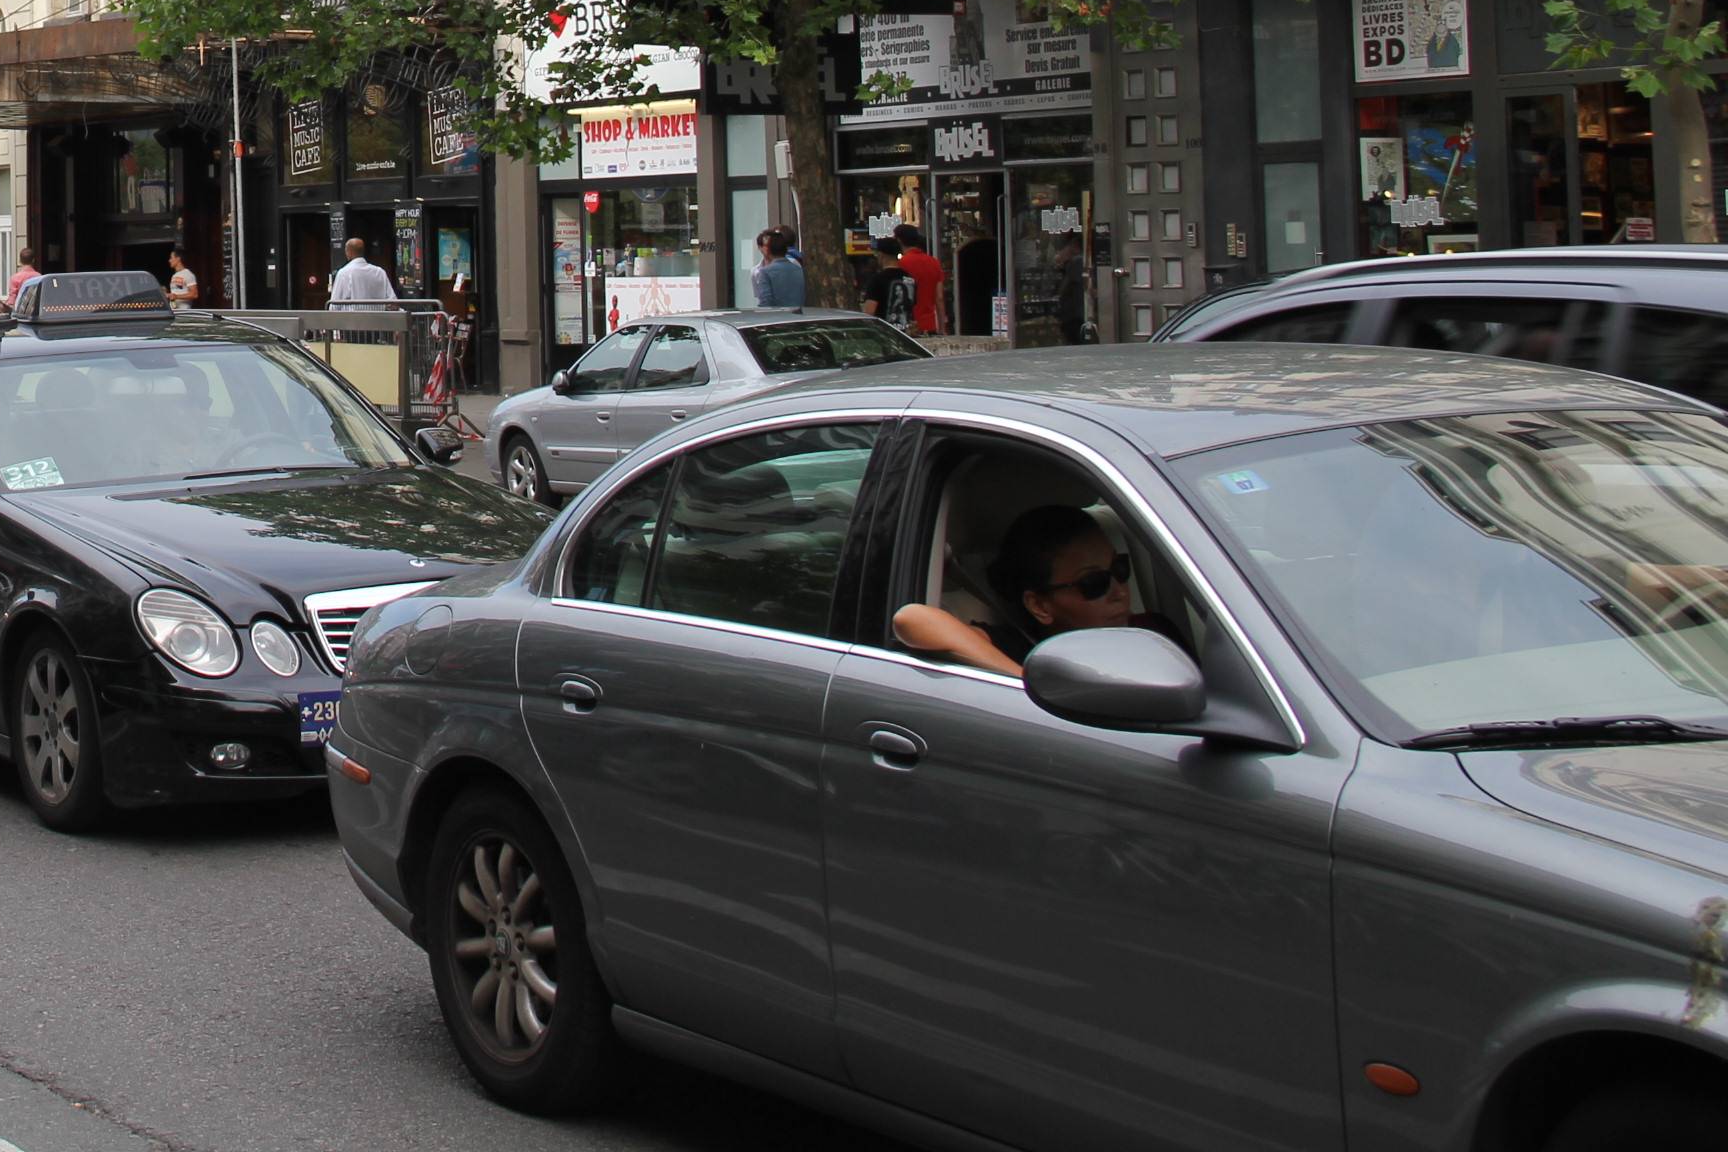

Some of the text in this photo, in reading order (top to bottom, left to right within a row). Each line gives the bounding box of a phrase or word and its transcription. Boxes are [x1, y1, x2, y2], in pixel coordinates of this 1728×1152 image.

[1362, 12, 1404, 25] LIVRES
[878, 23, 925, 42] permanente
[1006, 28, 1038, 43] Service
[1363, 24, 1405, 38] EXPOS
[1027, 38, 1077, 55] sur mesure
[1364, 38, 1405, 68] BD
[1024, 55, 1081, 73] Devis Gratuit
[1035, 77, 1071, 91] GALERIE
[583, 112, 697, 144] SHOP & MARKET
[293, 127, 320, 148] MUSIC
[395, 208, 420, 218] HAPPY HOUR
[395, 218, 417, 228] EVERY DAY
[71, 277, 133, 299] TAXI
[7, 460, 50, 481] 312
